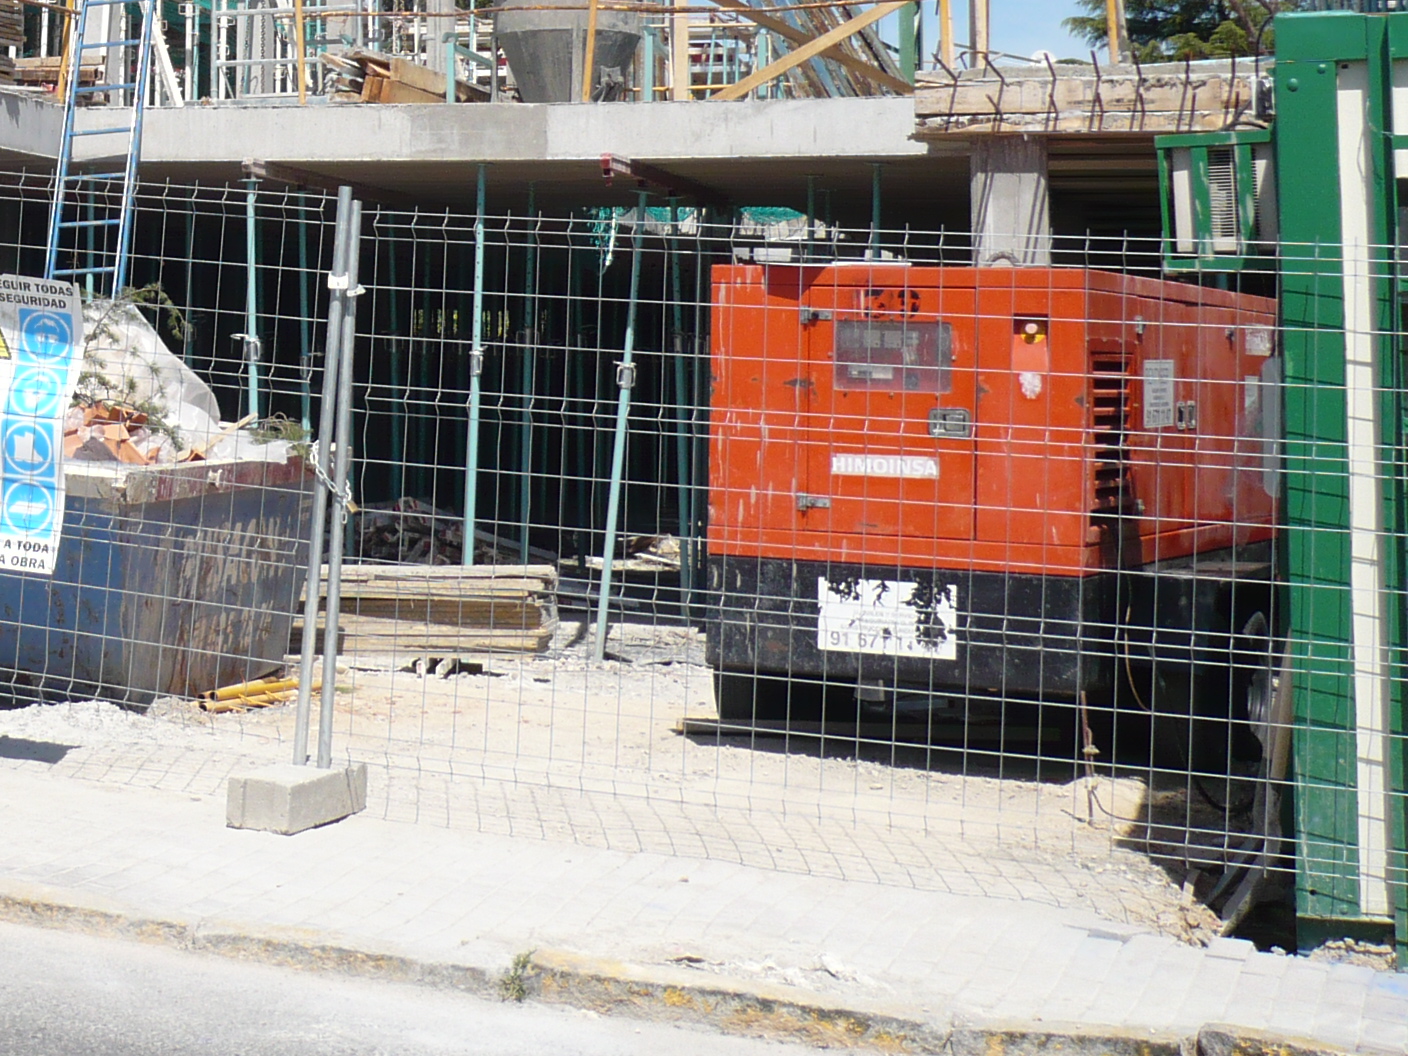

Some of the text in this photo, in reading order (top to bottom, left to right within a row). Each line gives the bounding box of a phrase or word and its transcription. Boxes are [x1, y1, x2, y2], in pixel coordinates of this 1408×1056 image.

[34, 284, 73, 297] TODAS
[832, 456, 938, 476] HIMOINSA
[3, 539, 12, 550] A
[17, 540, 50, 554] TODA
[10, 556, 46, 570] OBRA
